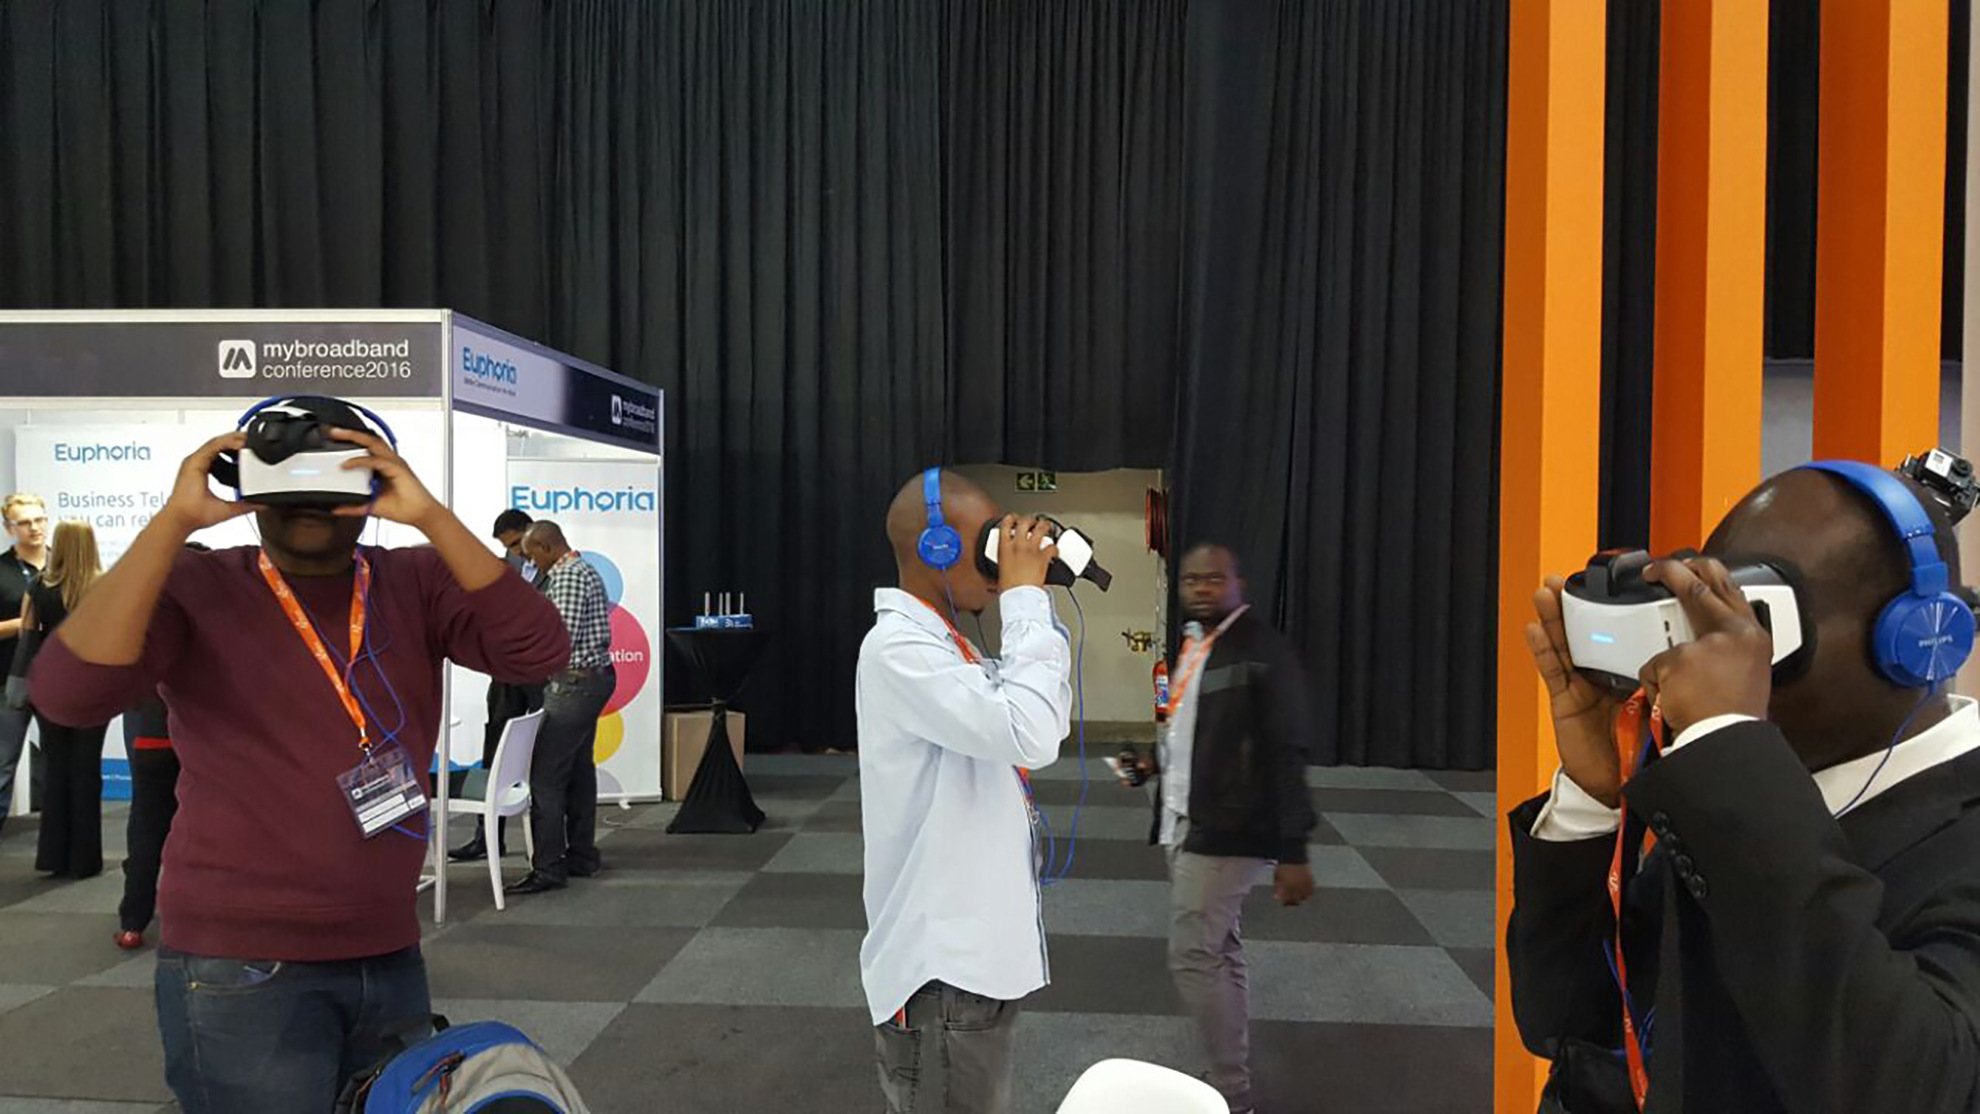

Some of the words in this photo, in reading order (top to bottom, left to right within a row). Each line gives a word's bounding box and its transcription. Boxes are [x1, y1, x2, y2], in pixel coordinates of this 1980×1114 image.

[263, 339, 409, 361] mybroadband
[262, 361, 411, 378] conference2016
[463, 346, 516, 384] Euphoria
[54, 441, 151, 464] Euphoria
[58, 491, 135, 508] Business
[139, 491, 168, 507] Tel
[511, 486, 654, 513] Euphoria
[96, 514, 125, 527] can
